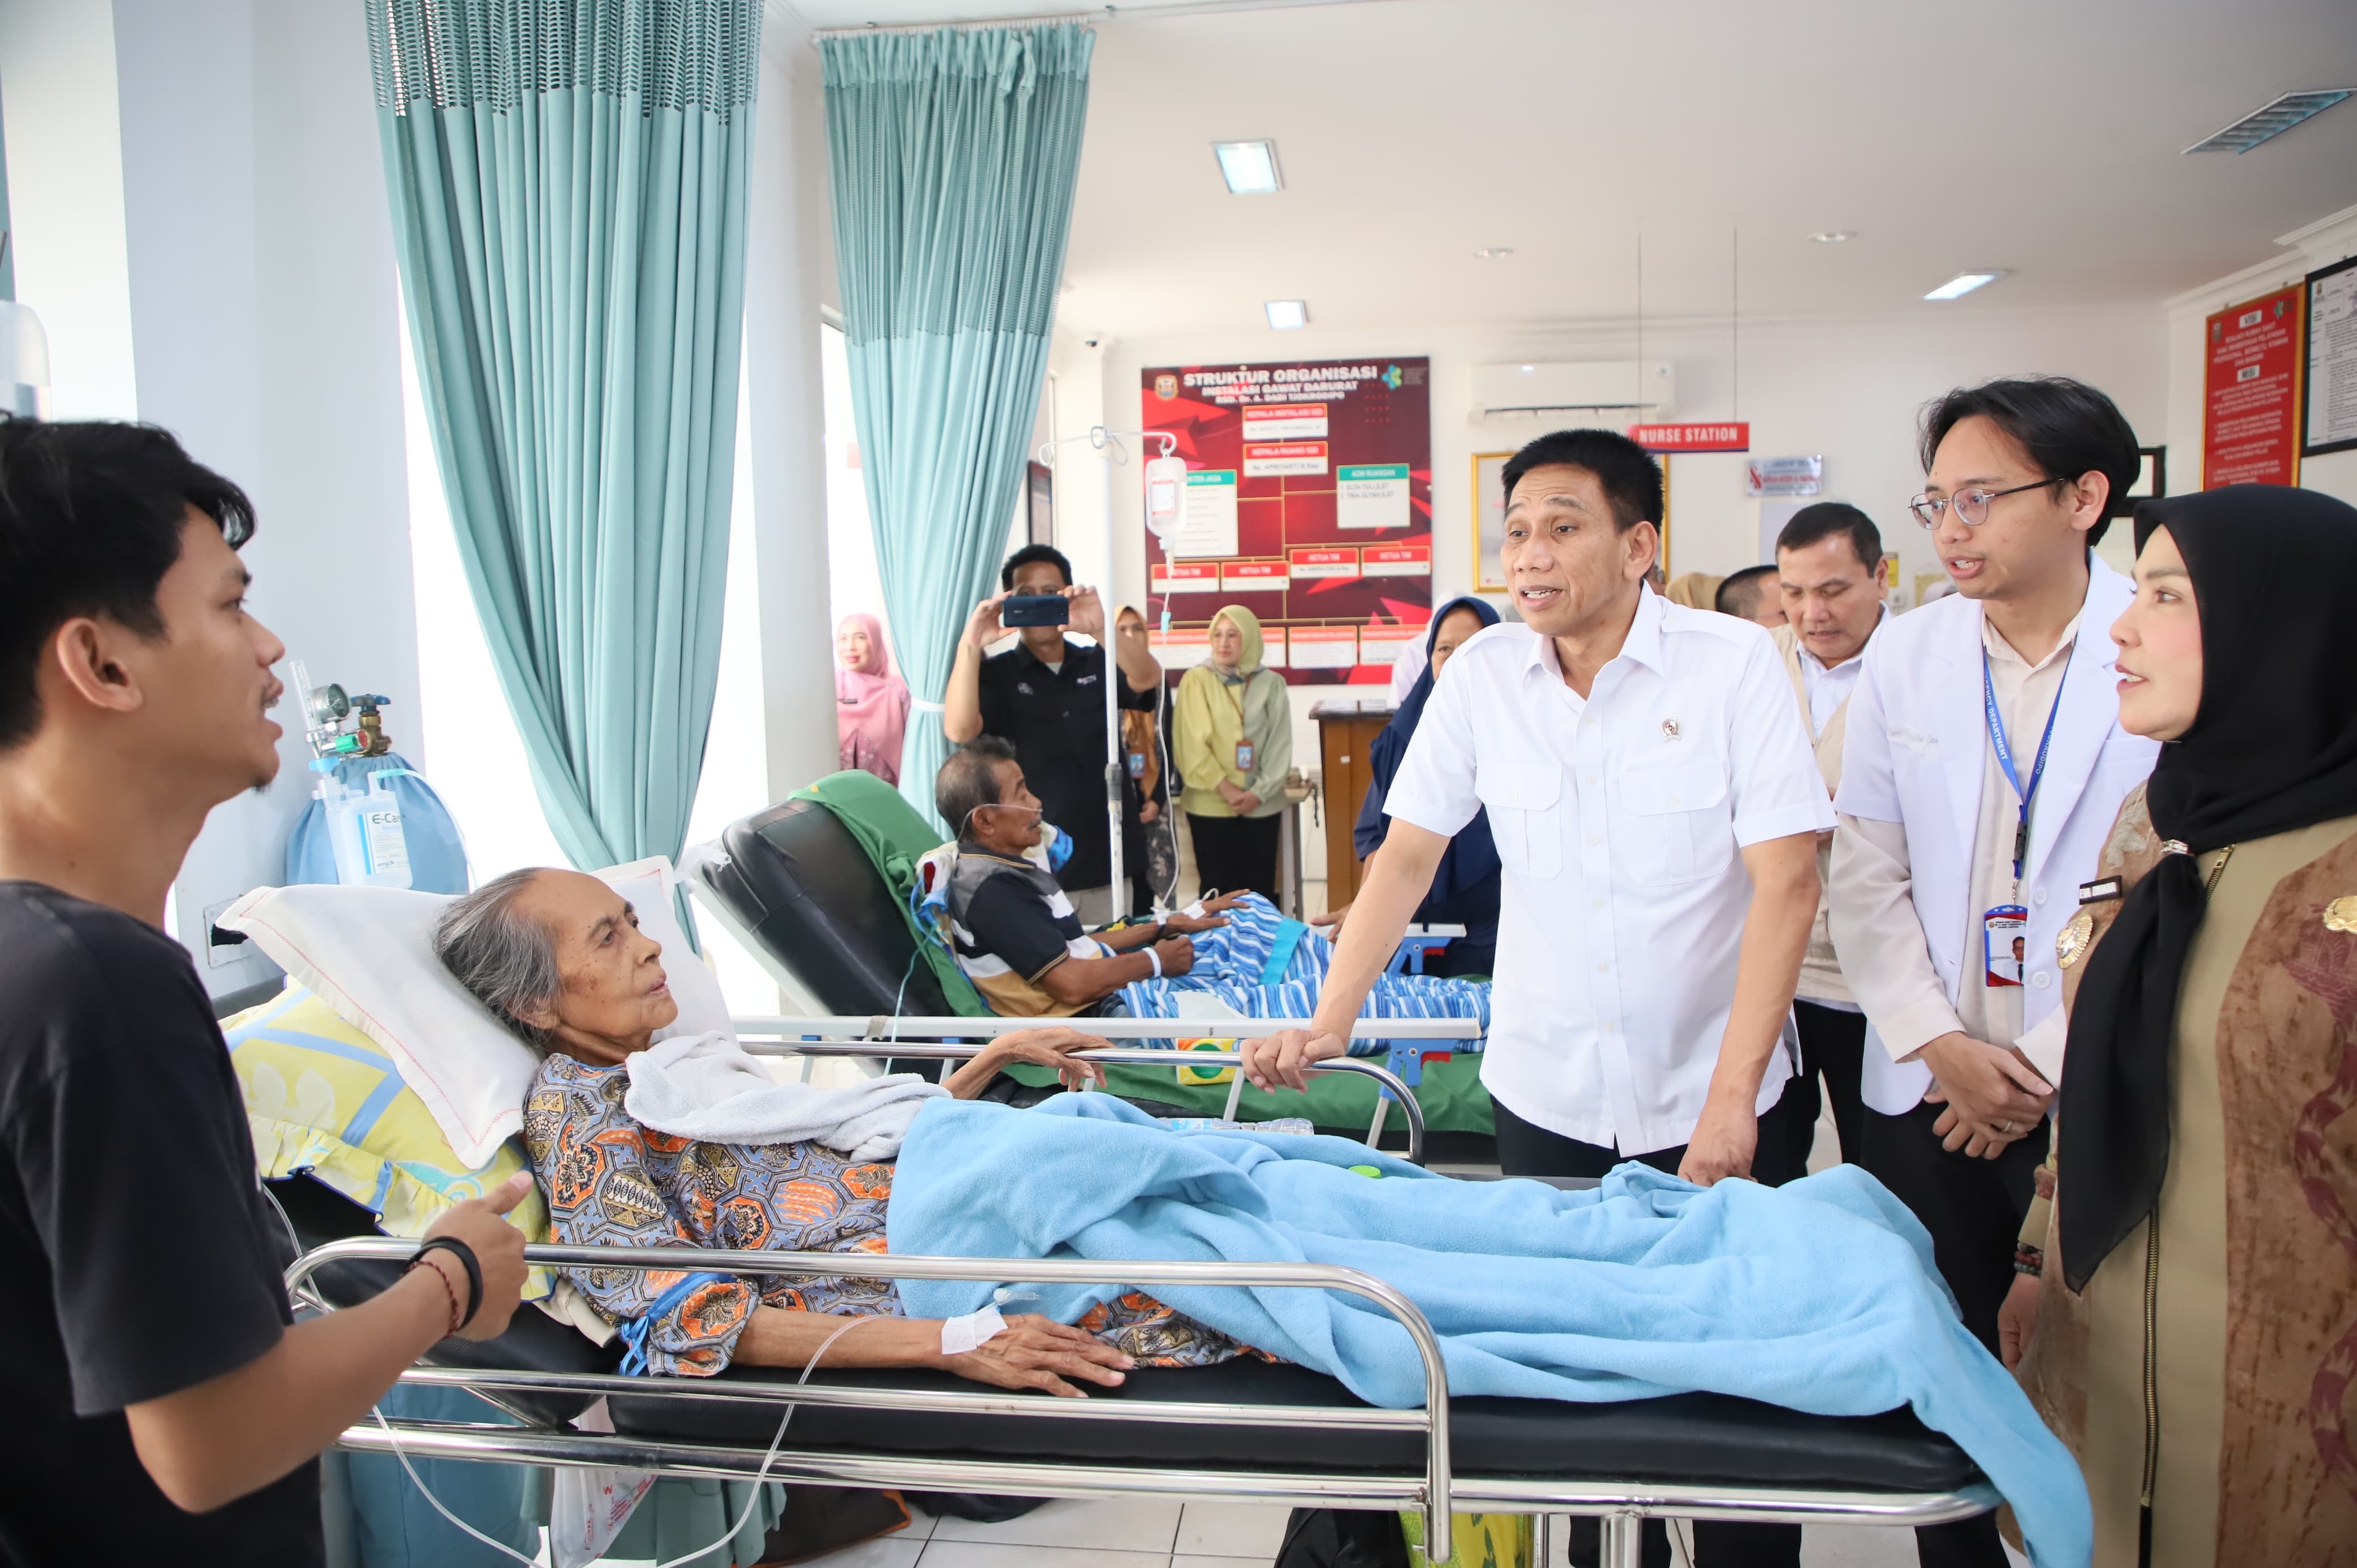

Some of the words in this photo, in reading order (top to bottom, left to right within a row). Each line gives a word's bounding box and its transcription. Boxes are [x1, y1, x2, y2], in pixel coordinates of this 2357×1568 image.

[1183, 370, 1270, 387] STRUKTUR
[1273, 366, 1378, 383] ORGANISASI
[1202, 385, 1261, 396] INSTALASI
[1262, 383, 1302, 394] GAWAT
[1303, 380, 1358, 392] DARURAT
[1639, 428, 1681, 443] NURSE
[1686, 427, 1738, 442] STATION
[1989, 708, 2008, 760] DEPARTMENT
